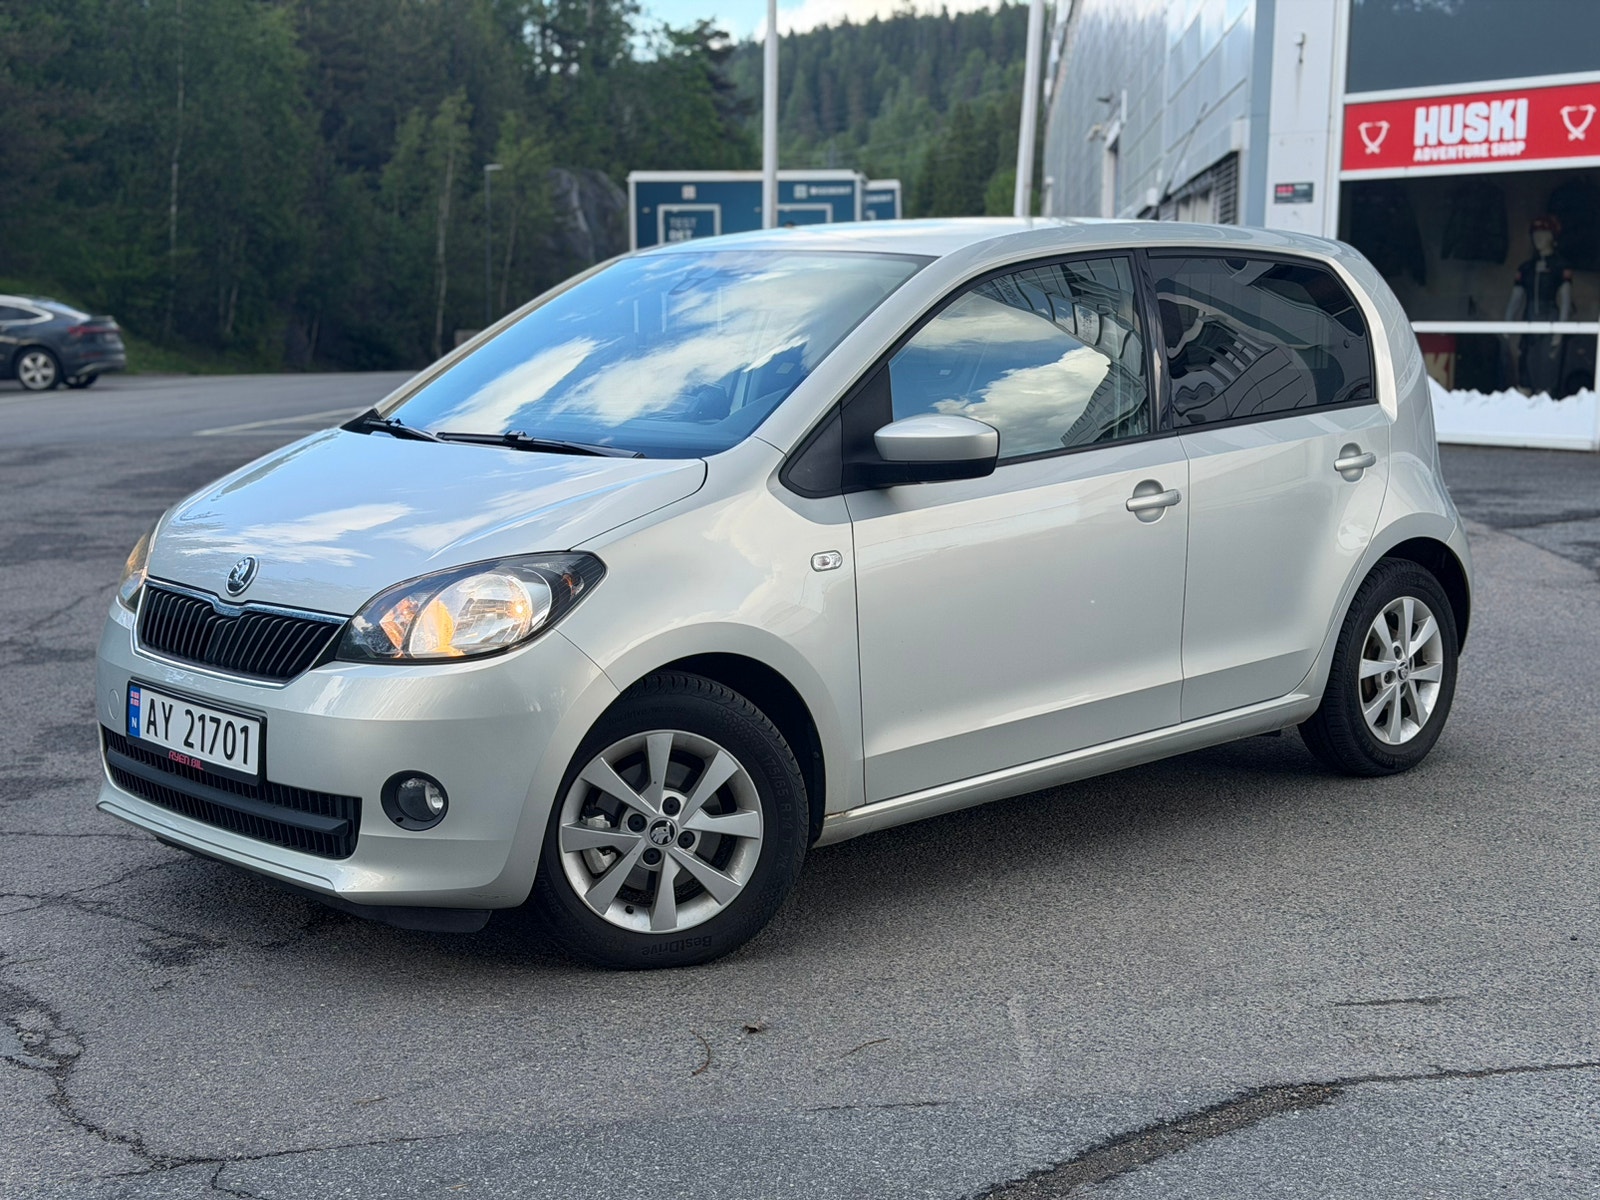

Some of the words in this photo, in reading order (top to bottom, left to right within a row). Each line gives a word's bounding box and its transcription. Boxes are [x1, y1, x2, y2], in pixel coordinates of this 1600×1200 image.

[1413, 98, 1529, 147] HUSKI
[1413, 143, 1489, 162] ADVENTURE
[1490, 141, 1526, 157] SHOP
[131, 717, 138, 729] N
[146, 698, 174, 741] AY
[183, 708, 250, 765] 21701
[641, 936, 712, 957] BestDrive
